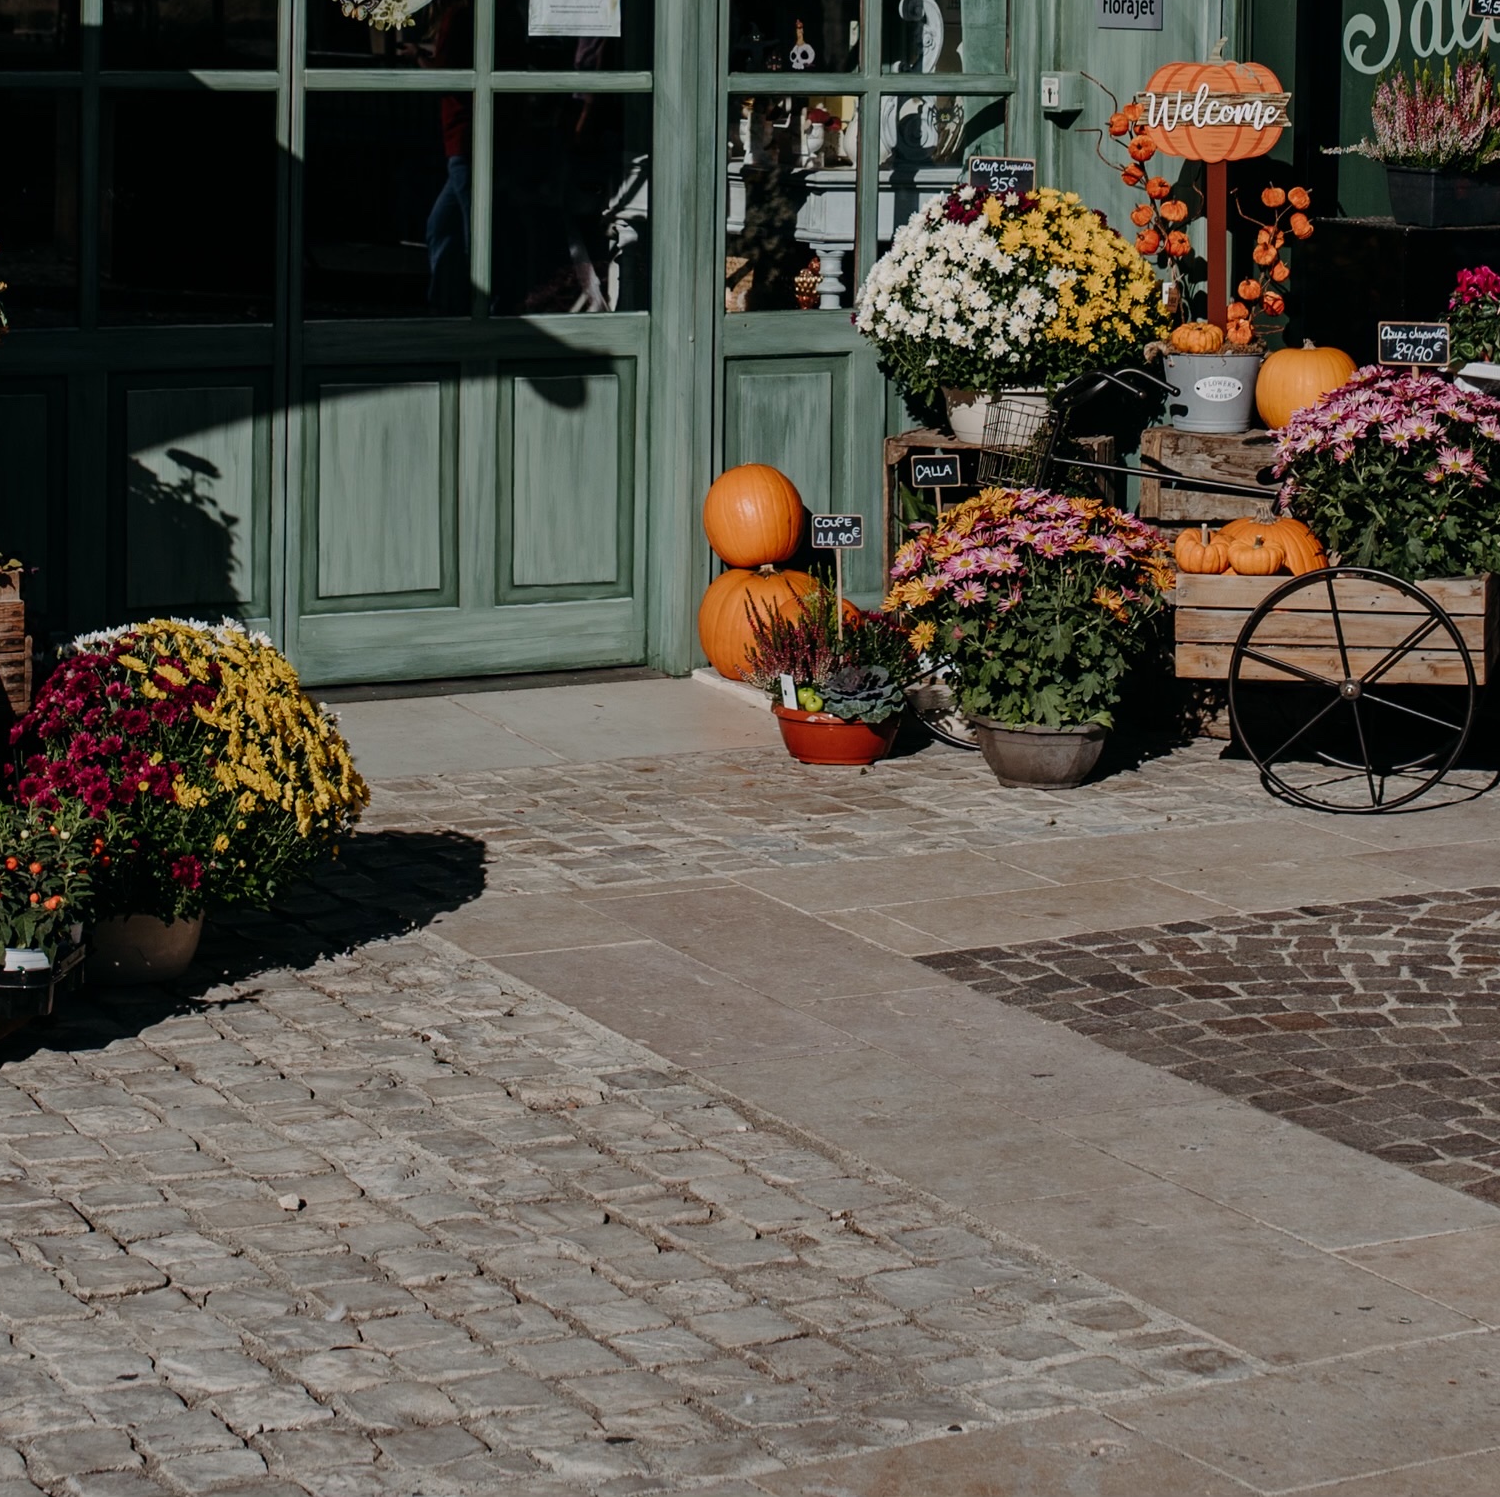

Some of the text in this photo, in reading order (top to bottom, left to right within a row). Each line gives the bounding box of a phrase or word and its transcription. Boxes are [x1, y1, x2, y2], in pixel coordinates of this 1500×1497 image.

[1146, 83, 1280, 131] Welcome
[987, 176, 1018, 192] 35€
[1203, 379, 1236, 388] FLOWERS
[814, 516, 852, 528] COUPE
